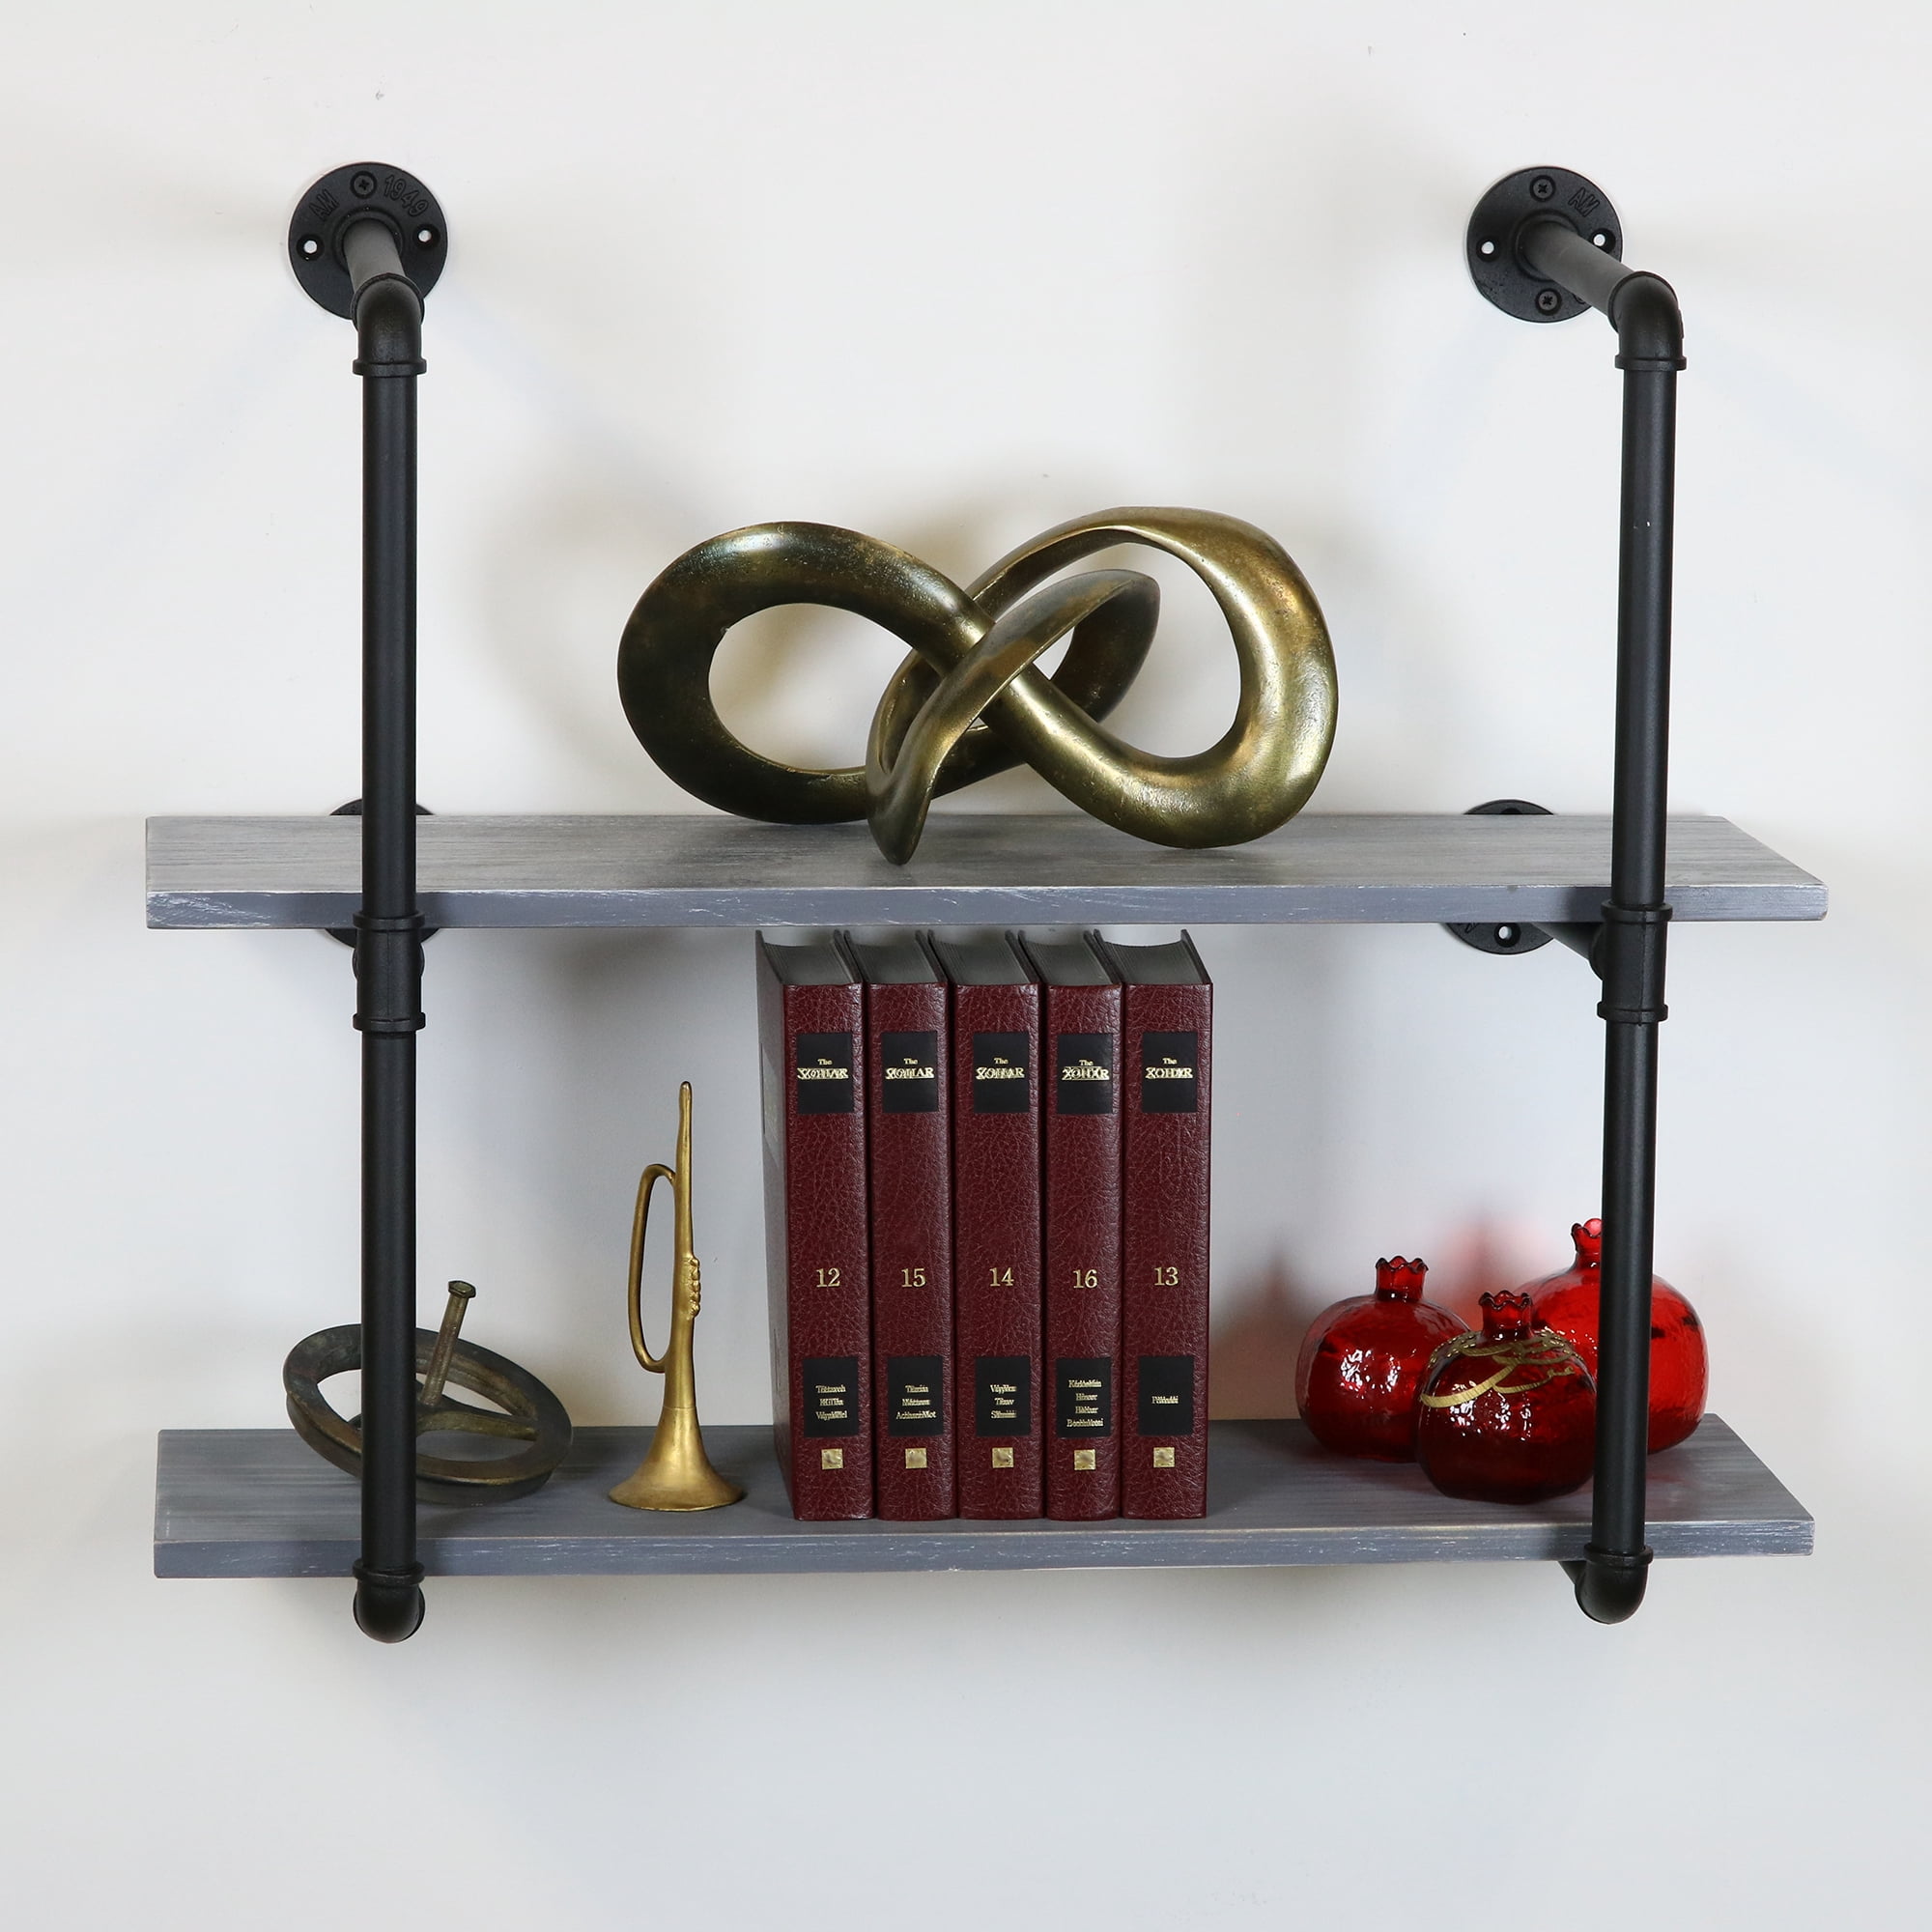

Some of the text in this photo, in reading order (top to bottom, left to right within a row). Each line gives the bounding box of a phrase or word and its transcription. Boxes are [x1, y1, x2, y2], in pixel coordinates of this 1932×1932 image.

[384, 174, 429, 217] 1949
[815, 1268, 840, 1288] 12
[900, 1267, 926, 1288] 15
[989, 1266, 1015, 1287] 14
[1072, 1268, 1099, 1289] 16
[1153, 1266, 1179, 1287] 13
